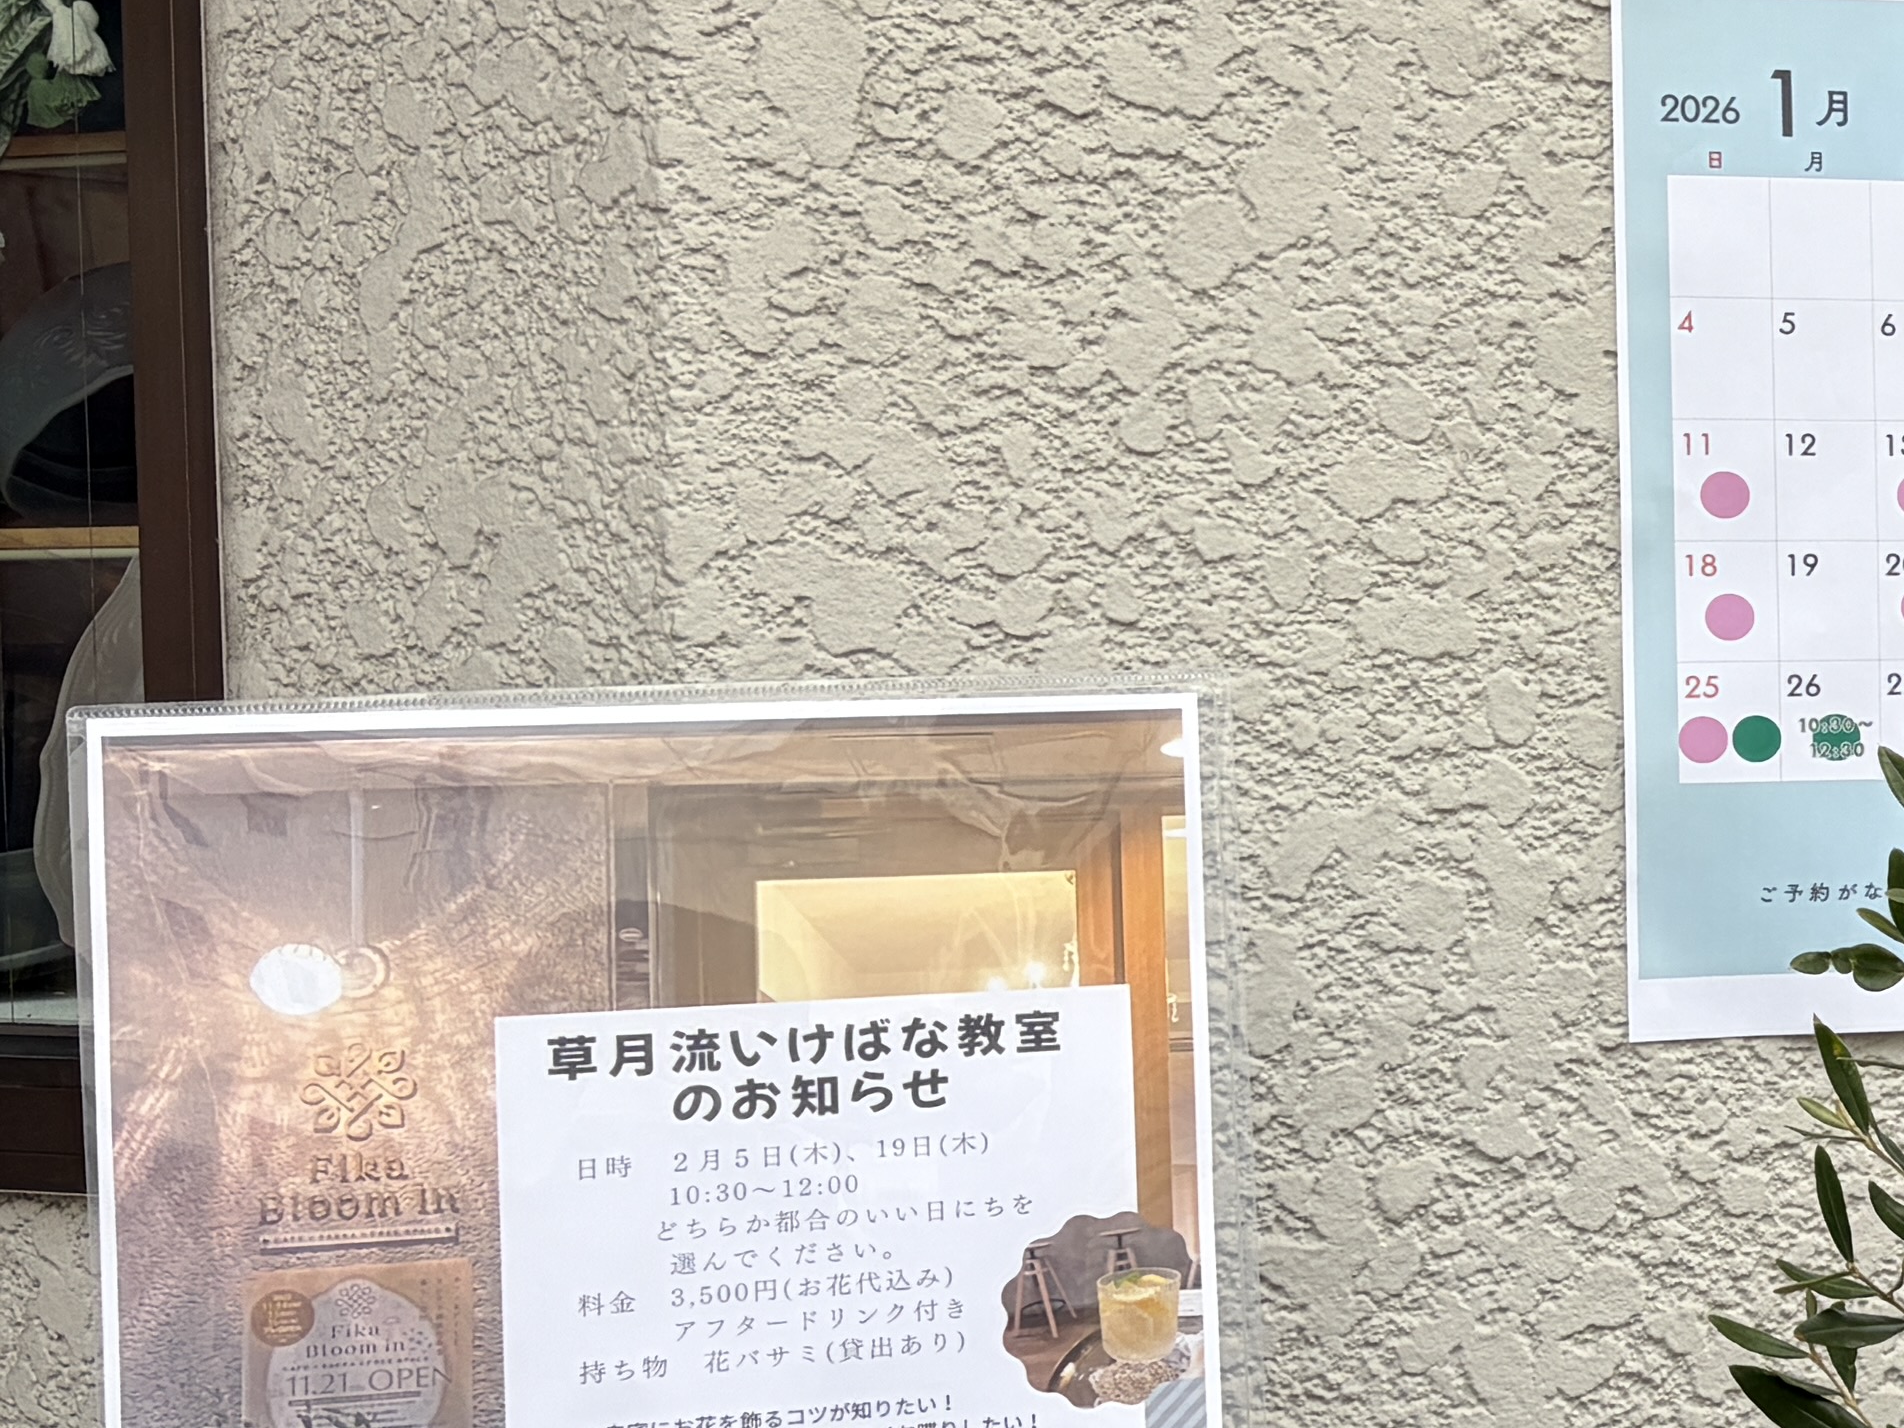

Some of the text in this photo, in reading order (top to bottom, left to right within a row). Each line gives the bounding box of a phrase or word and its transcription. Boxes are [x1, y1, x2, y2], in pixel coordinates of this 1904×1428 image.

[1659, 93, 1741, 125] 2026
[1706, 148, 1723, 170] 日
[1803, 151, 1823, 173] 月
[1677, 309, 1695, 334] 4
[1778, 311, 1796, 336] 5
[1880, 313, 1897, 337] 6
[1682, 432, 1710, 456] 11
[1784, 432, 1817, 457] 12
[1684, 553, 1718, 578] 18
[1787, 552, 1819, 577] 19
[1684, 674, 1720, 699] 25
[1786, 673, 1822, 698] 26
[547, 1010, 1062, 1081] 草月流いけばな教室
[673, 1070, 949, 1122] のお知らせ
[577, 1154, 632, 1180] 日時
[656, 1194, 1034, 1241] どちらか都合のいい日にちを
[669, 1243, 894, 1276] 選んでください。
[578, 1290, 637, 1317] 料金
[674, 1298, 967, 1342] アフタードリンク付き
[368, 1366, 453, 1391] OPEN
[579, 1354, 668, 1386] 持ち物
